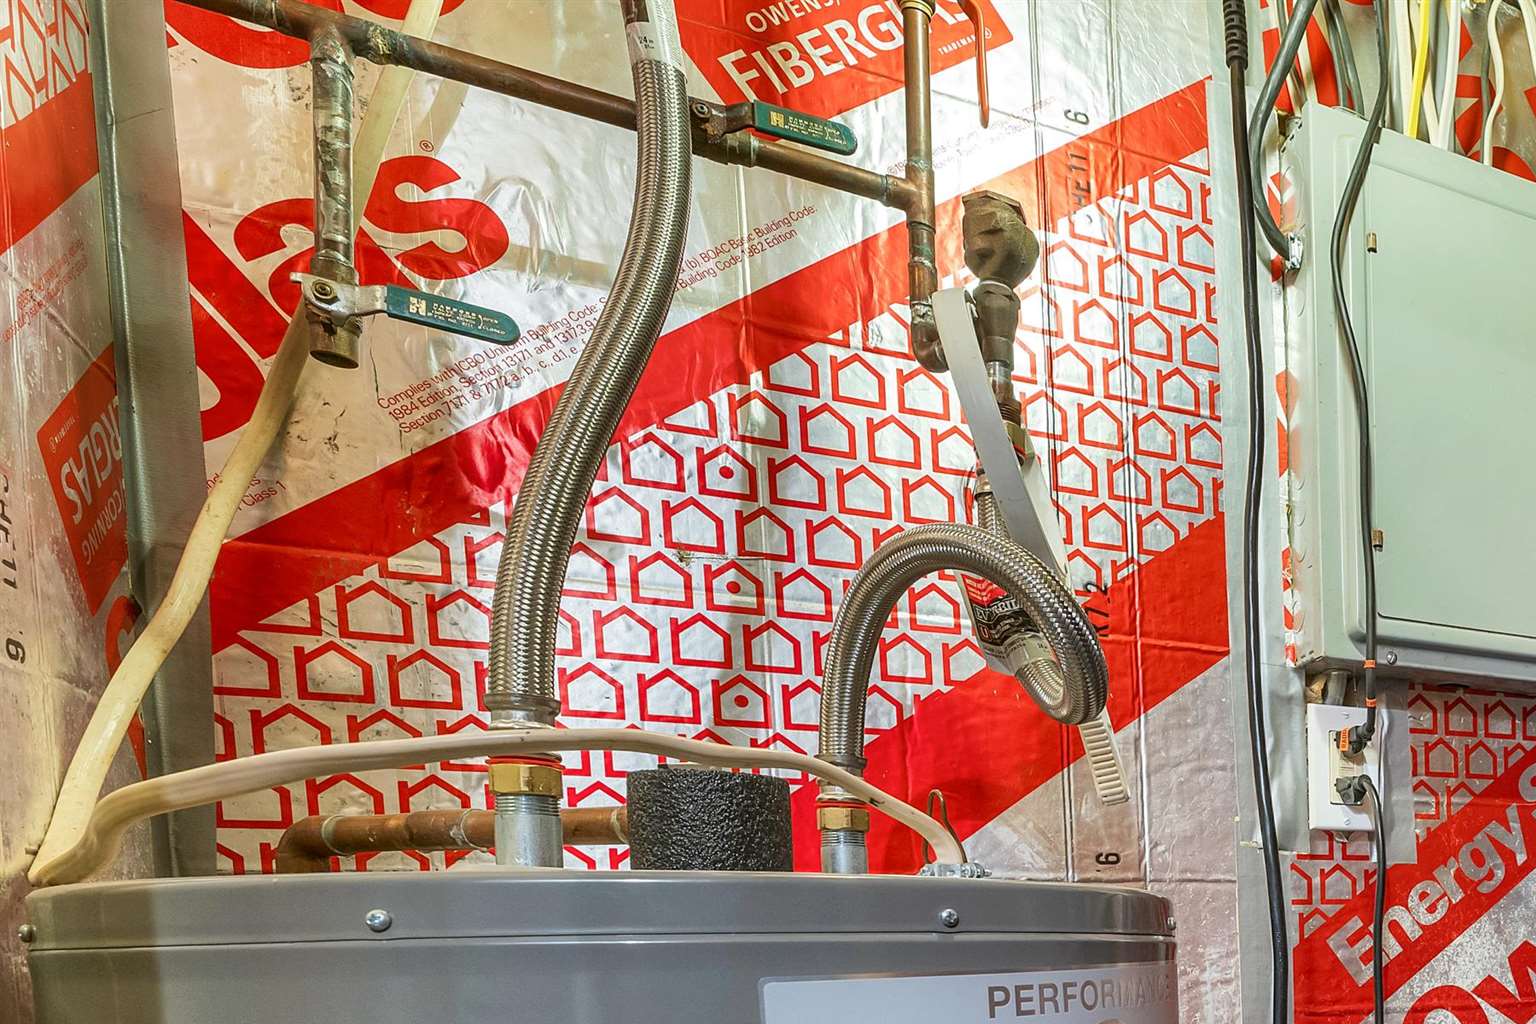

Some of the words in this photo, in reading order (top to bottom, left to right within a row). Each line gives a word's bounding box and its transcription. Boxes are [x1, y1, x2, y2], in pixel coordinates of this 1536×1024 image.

[756, 214, 793, 239] Building
[767, 226, 798, 247] Edition
[377, 376, 431, 413] Complies
[432, 366, 457, 386] with
[389, 400, 419, 422] 1984
[460, 361, 502, 390] Section
[534, 338, 554, 355] and
[399, 405, 443, 435] Section
[1327, 803, 1536, 988] Energy
